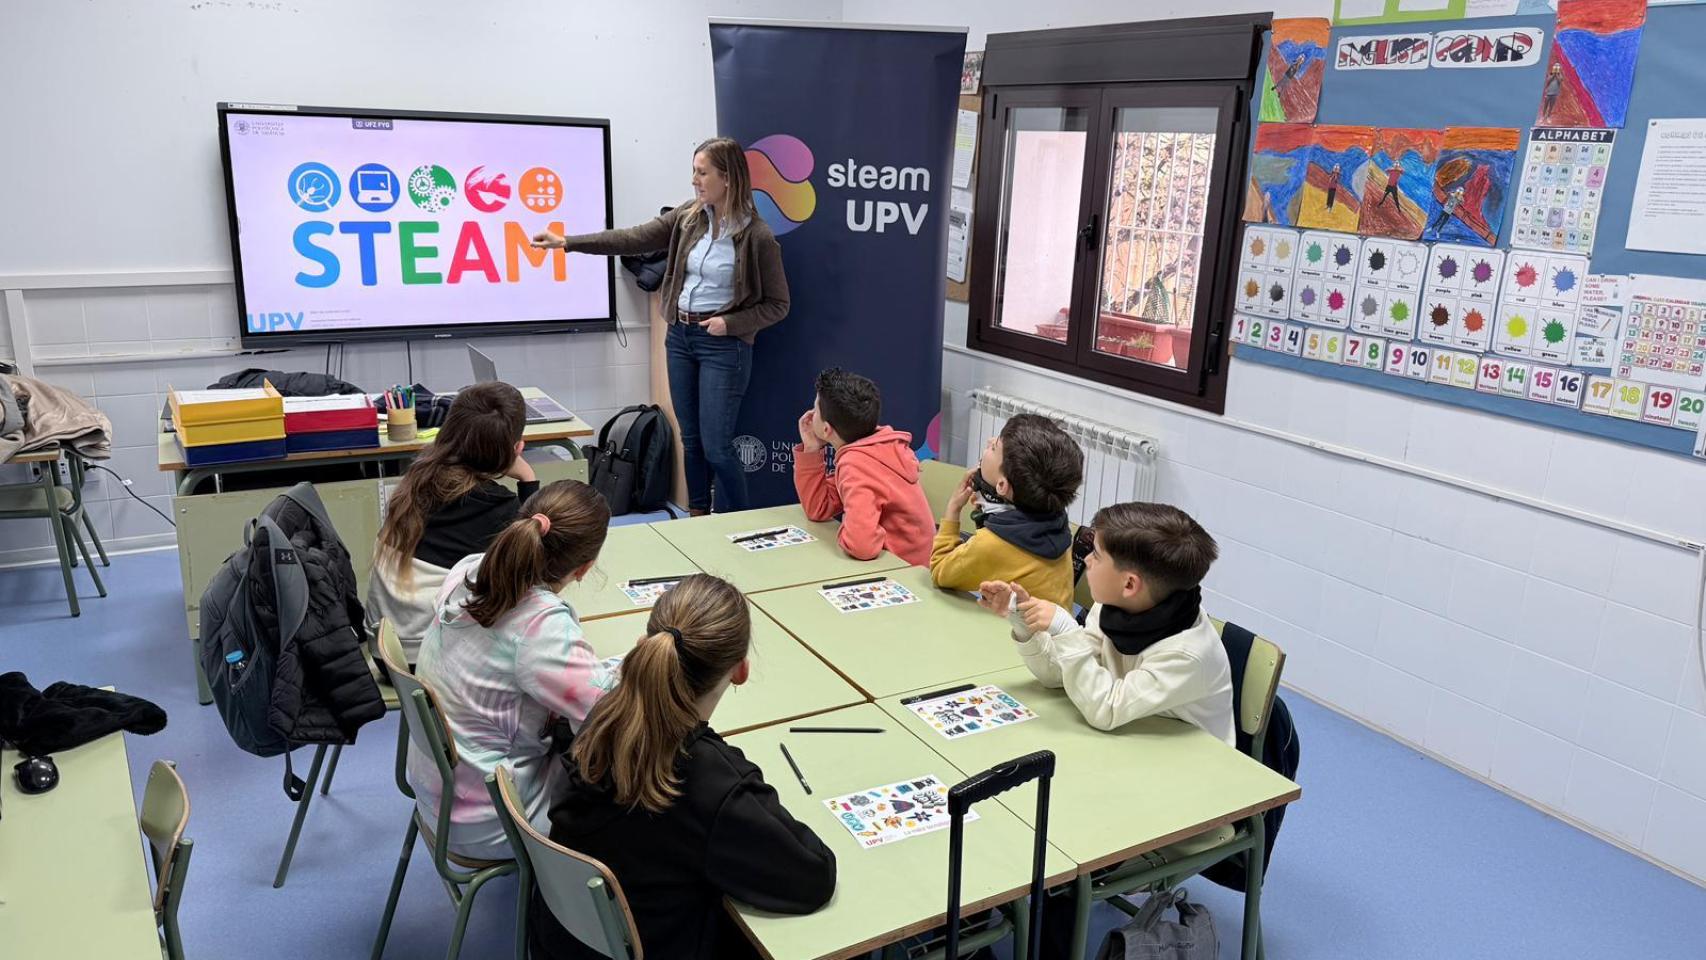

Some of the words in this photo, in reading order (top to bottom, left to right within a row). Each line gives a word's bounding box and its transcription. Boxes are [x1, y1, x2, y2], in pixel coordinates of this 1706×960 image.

[1436, 32, 1533, 63] CORNER
[1539, 131, 1607, 141] ALPHABET
[827, 158, 930, 192] steam
[845, 200, 929, 235] UPV
[292, 220, 567, 288] STEAM
[248, 312, 304, 332] UPV
[1238, 319, 1243, 334] 1
[1251, 322, 1261, 338] 2
[1271, 326, 1281, 342] 3
[1288, 330, 1299, 346] 4
[1309, 334, 1318, 350] 5
[1327, 337, 1338, 353] 6
[1349, 340, 1360, 355] 7
[1369, 343, 1379, 359] 8
[1392, 348, 1403, 365] 9
[1411, 351, 1427, 366] 10
[1436, 355, 1450, 370] 11
[1457, 358, 1476, 375] 12
[1482, 363, 1500, 379] 13
[1506, 367, 1525, 384] 14
[1534, 371, 1553, 388] 15
[1559, 375, 1579, 392] 16
[1591, 382, 1612, 399] 17
[1619, 386, 1641, 405] 18
[1651, 390, 1673, 409] 19
[1679, 397, 1704, 414] 20
[772, 463, 786, 473] DE
